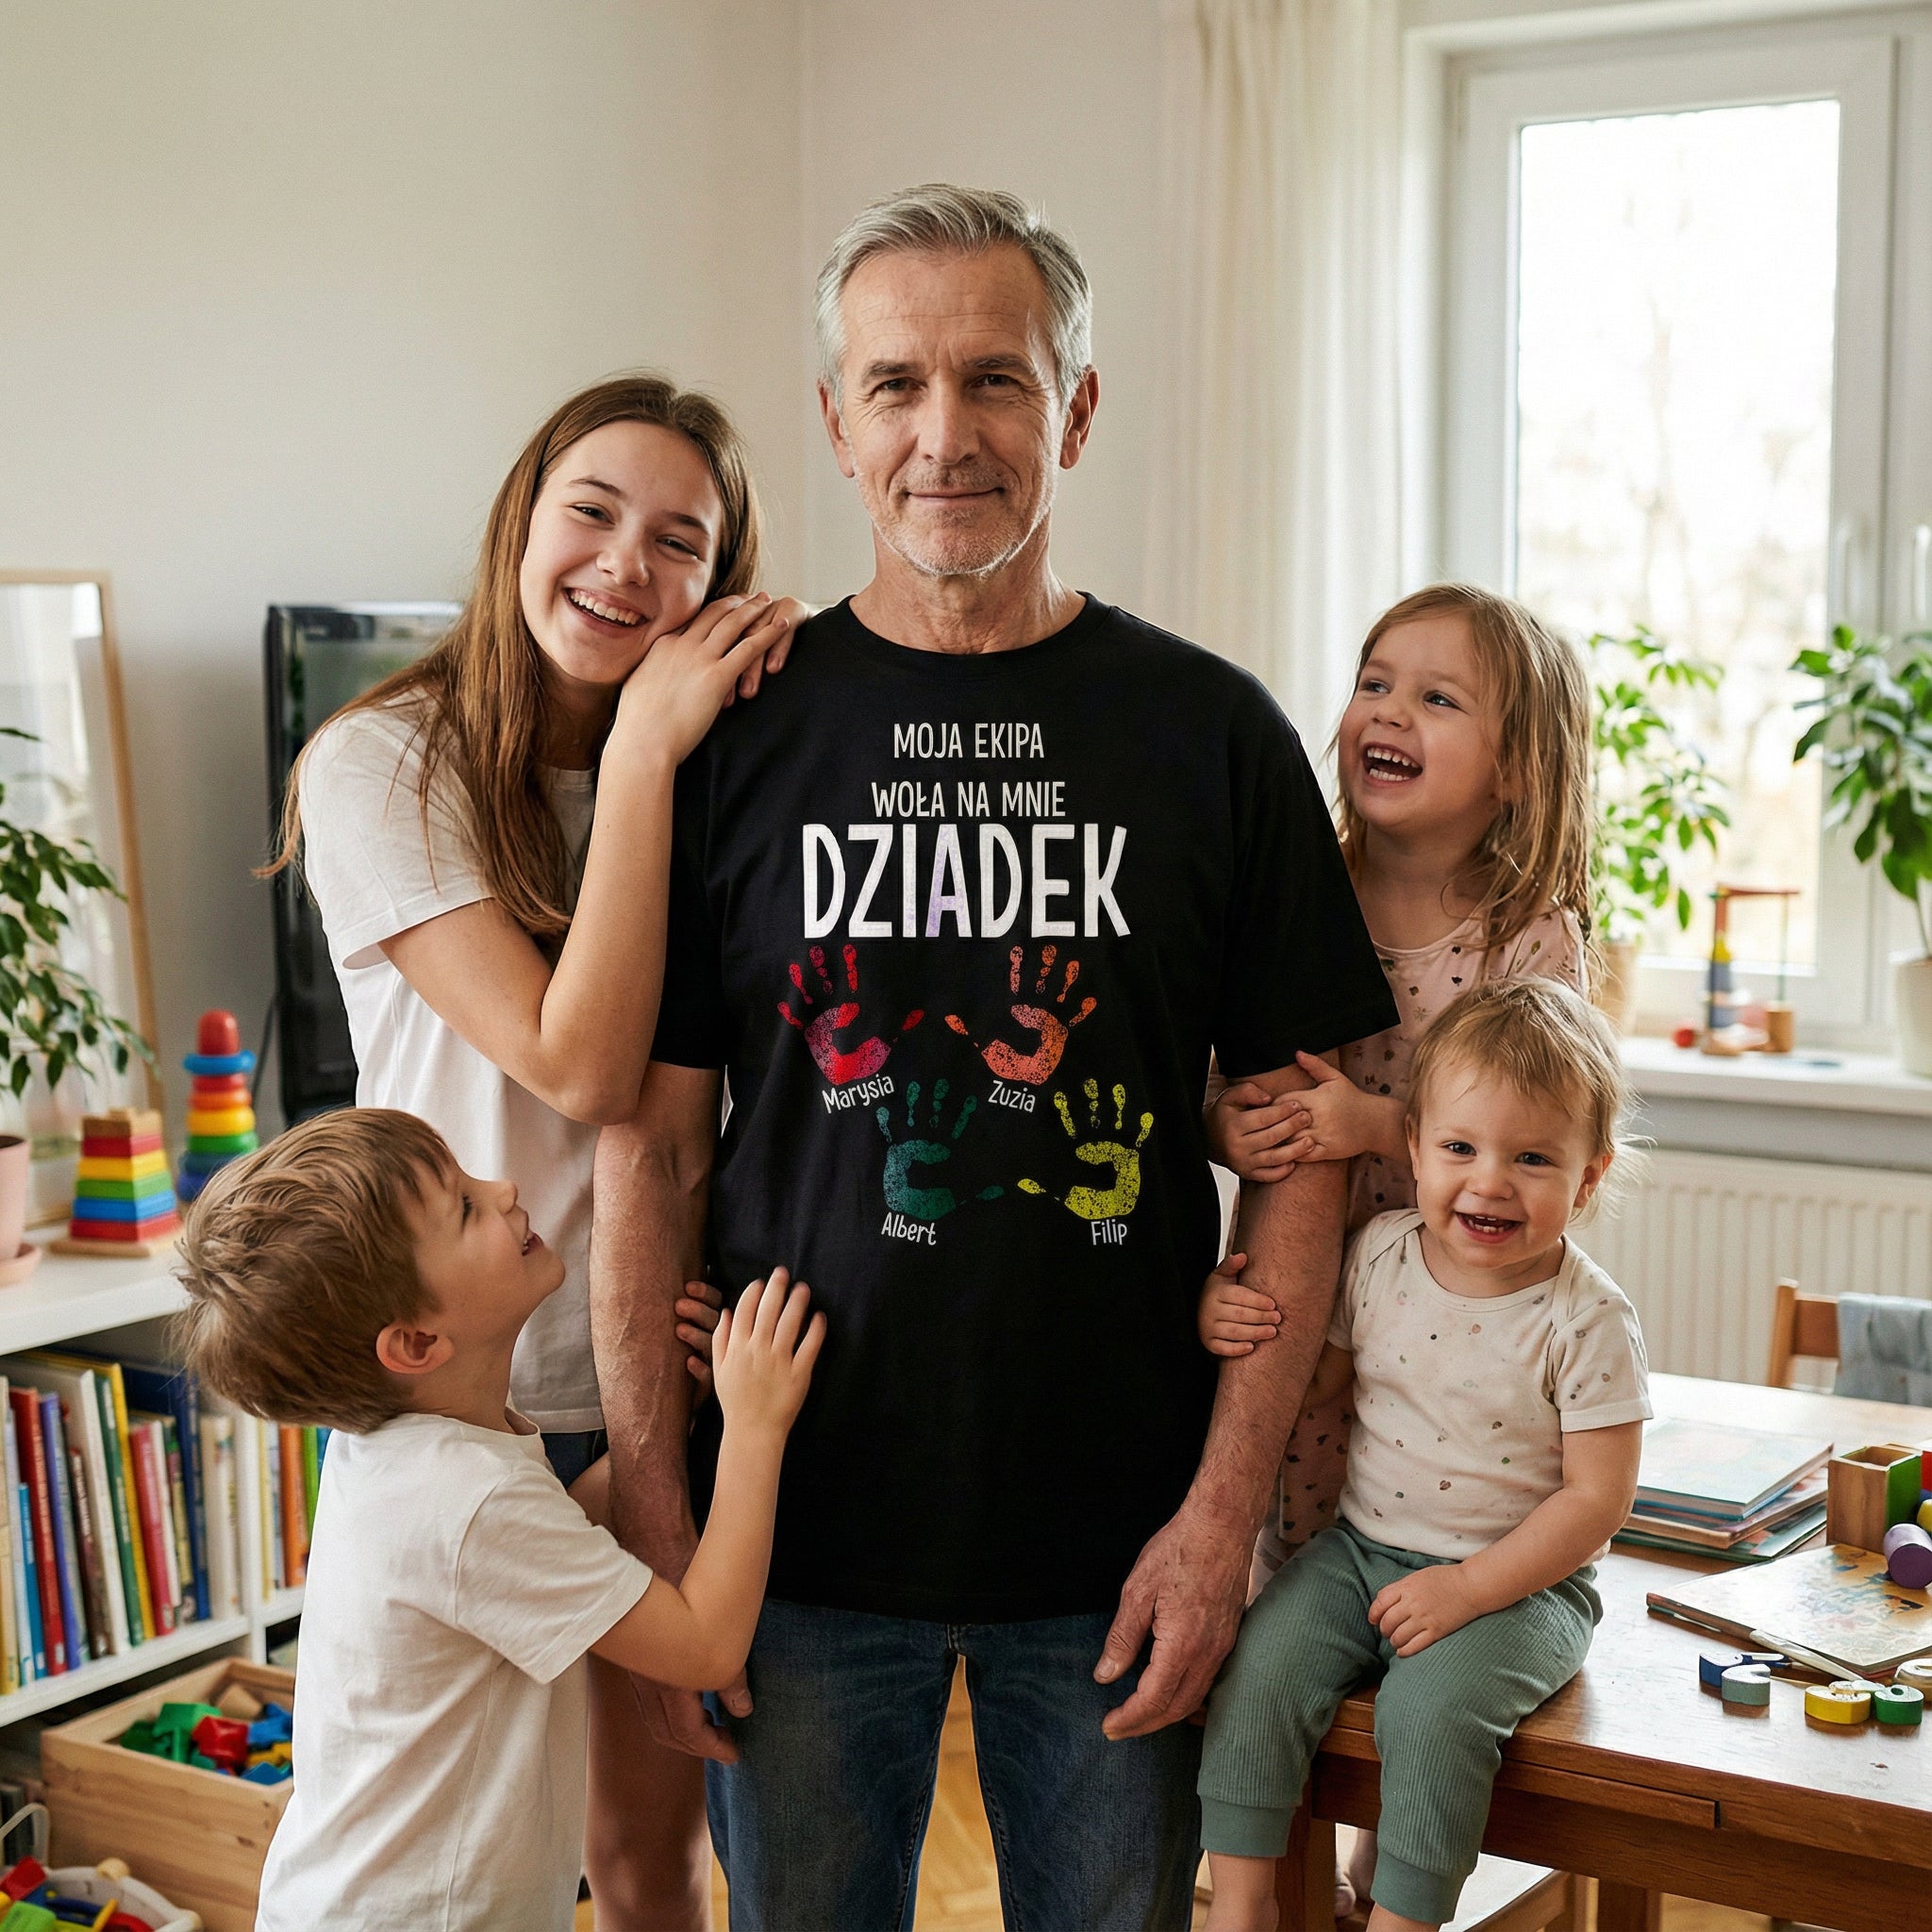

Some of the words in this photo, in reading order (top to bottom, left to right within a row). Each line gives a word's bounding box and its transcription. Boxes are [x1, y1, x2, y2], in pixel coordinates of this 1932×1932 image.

[894, 723, 962, 758] MOJA
[975, 724, 1044, 758] EKIPA
[872, 781, 945, 817] WOŁA
[958, 782, 990, 817] NA
[1003, 782, 1065, 816] MNIE
[803, 824, 1130, 939] DZIADEK
[822, 1074, 893, 1113] Marysia
[989, 1080, 1035, 1112] Zuzia
[881, 1212, 936, 1245] Albert
[1091, 1219, 1127, 1245] Filip
